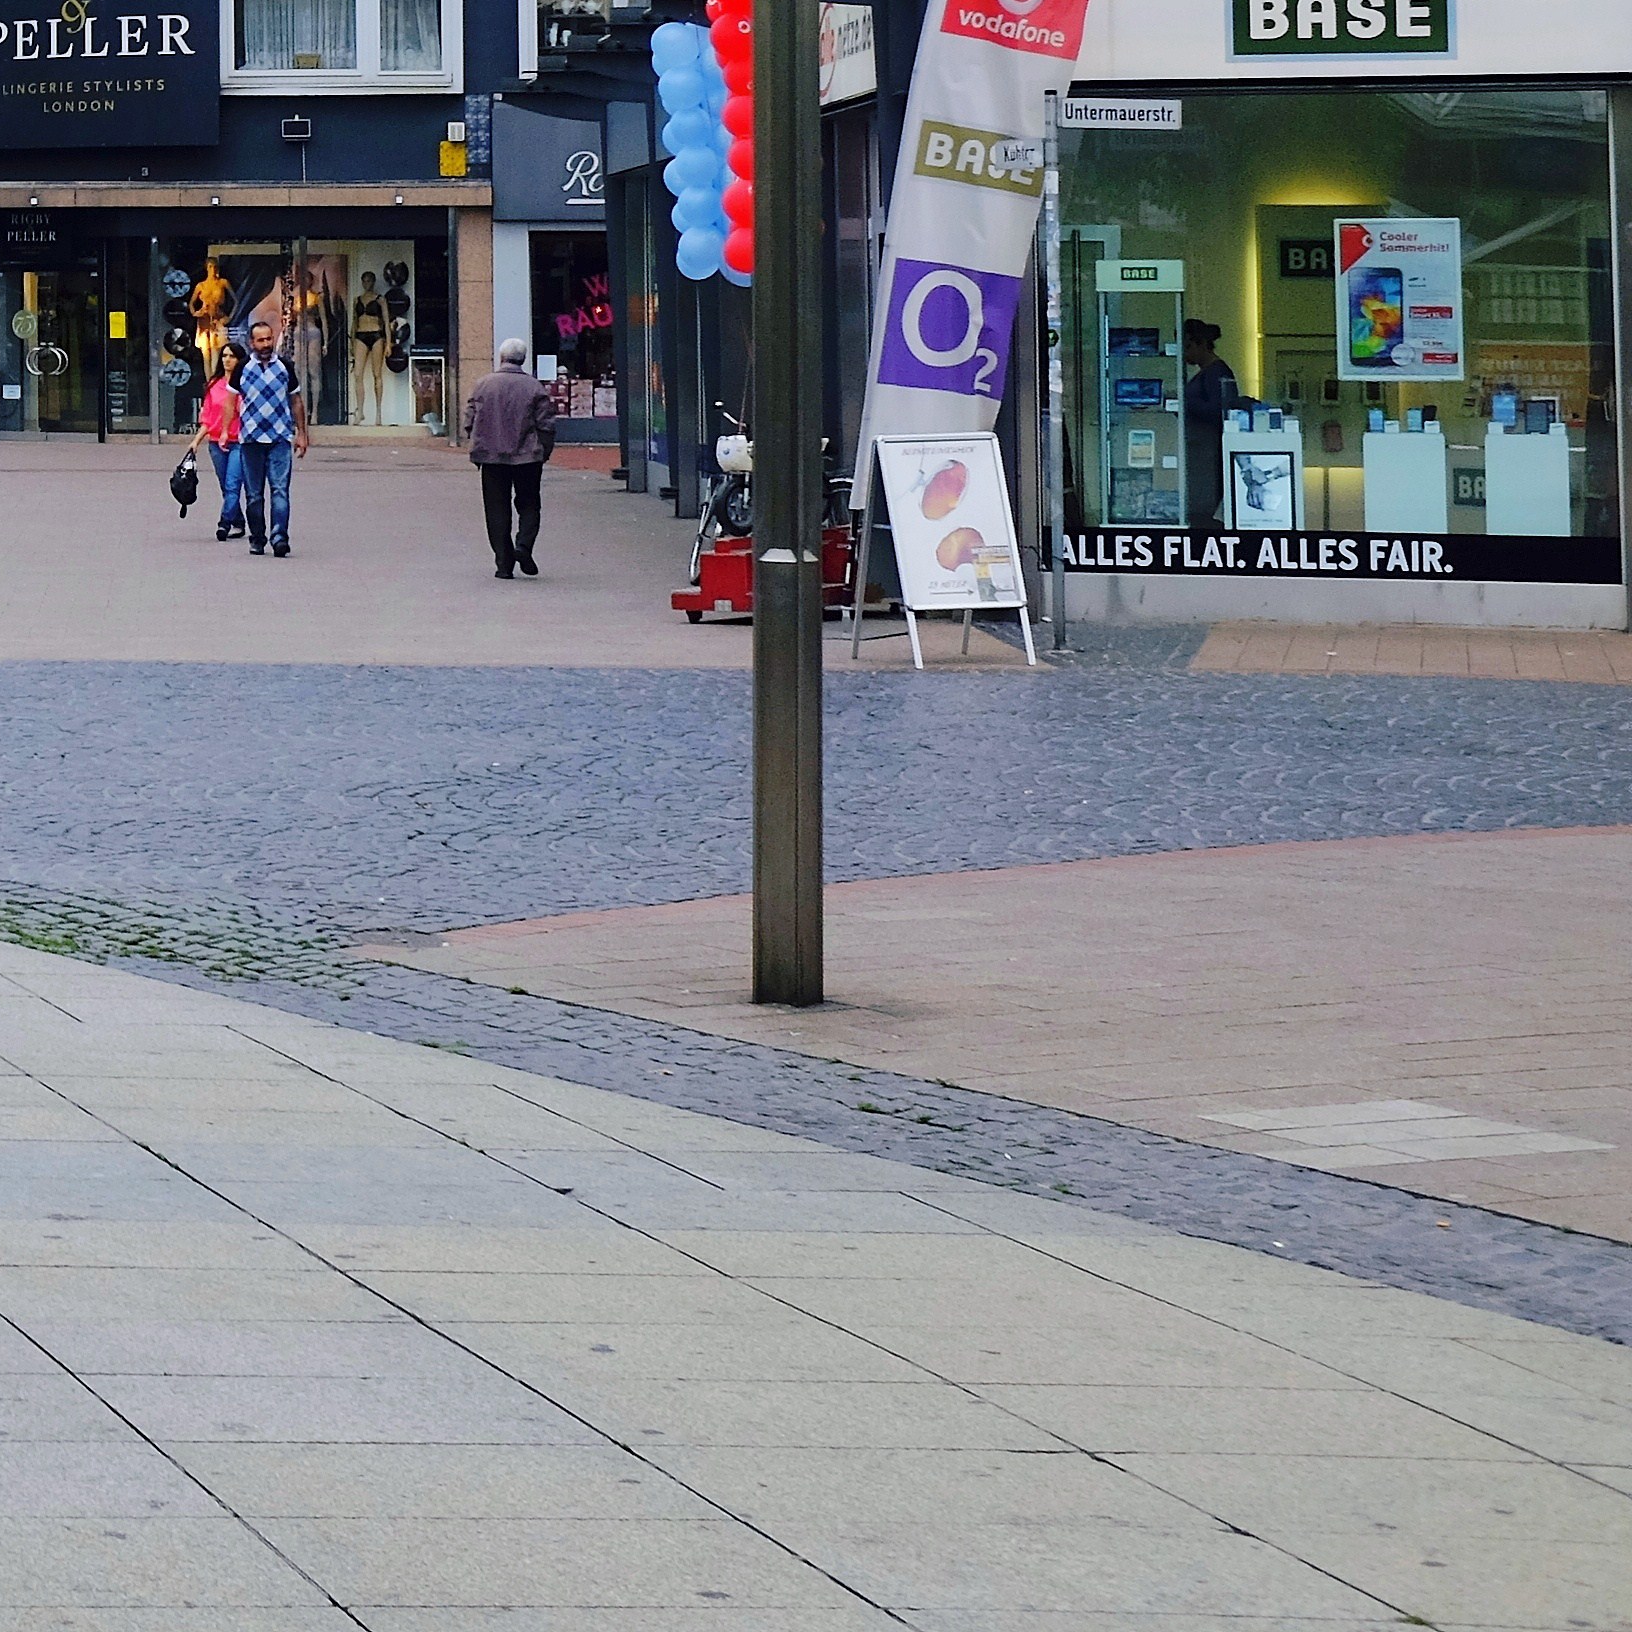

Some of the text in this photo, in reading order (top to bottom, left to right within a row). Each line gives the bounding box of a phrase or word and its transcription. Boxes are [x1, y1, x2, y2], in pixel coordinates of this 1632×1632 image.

[958, 8, 1066, 49] vodafone
[2, 78, 166, 96] LINGERIE STYLISTS
[43, 100, 115, 113] LONDON
[1064, 102, 1177, 124] Untermauerstr.
[7, 230, 57, 242] PELLER
[1379, 231, 1419, 241] Cooler
[1379, 242, 1449, 253] Sommerhit!
[1288, 247, 1328, 270] BA
[1122, 268, 1156, 279] BASE
[1458, 475, 1486, 499] BA
[1062, 533, 1455, 573] ALLES FLAT. ALLES FAIR.
